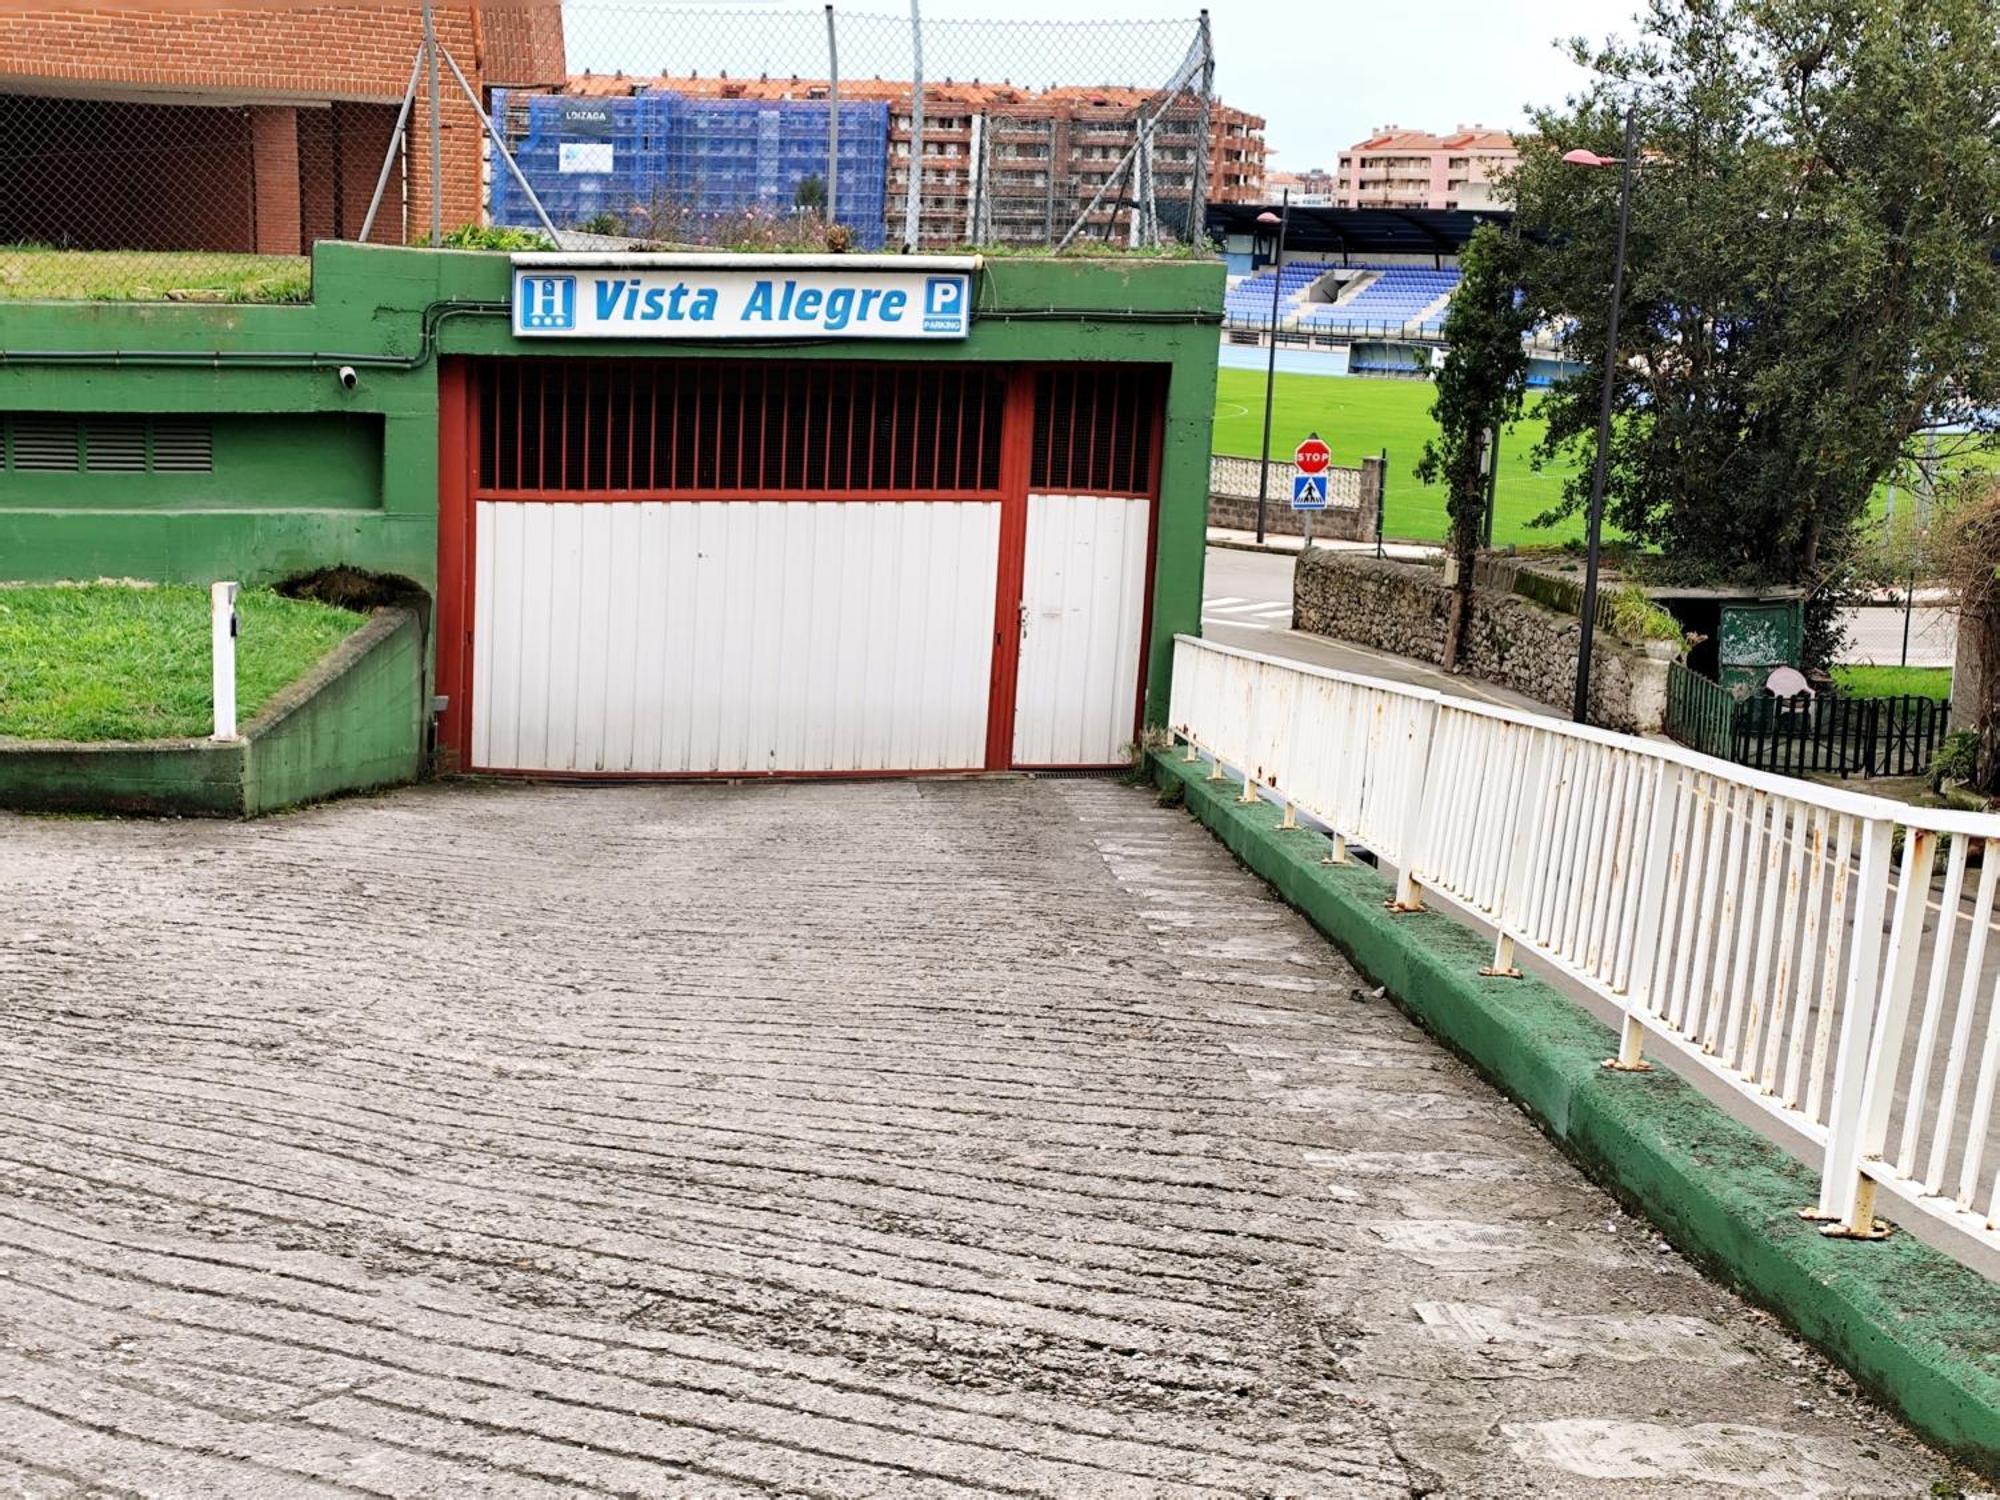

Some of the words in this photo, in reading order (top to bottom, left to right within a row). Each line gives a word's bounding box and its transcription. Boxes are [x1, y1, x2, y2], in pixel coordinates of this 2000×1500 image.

[595, 279, 718, 321] Vista
[740, 280, 908, 331] Alegre
[932, 283, 958, 312] P
[924, 320, 960, 330] PARKING
[1297, 453, 1329, 461] STOP
